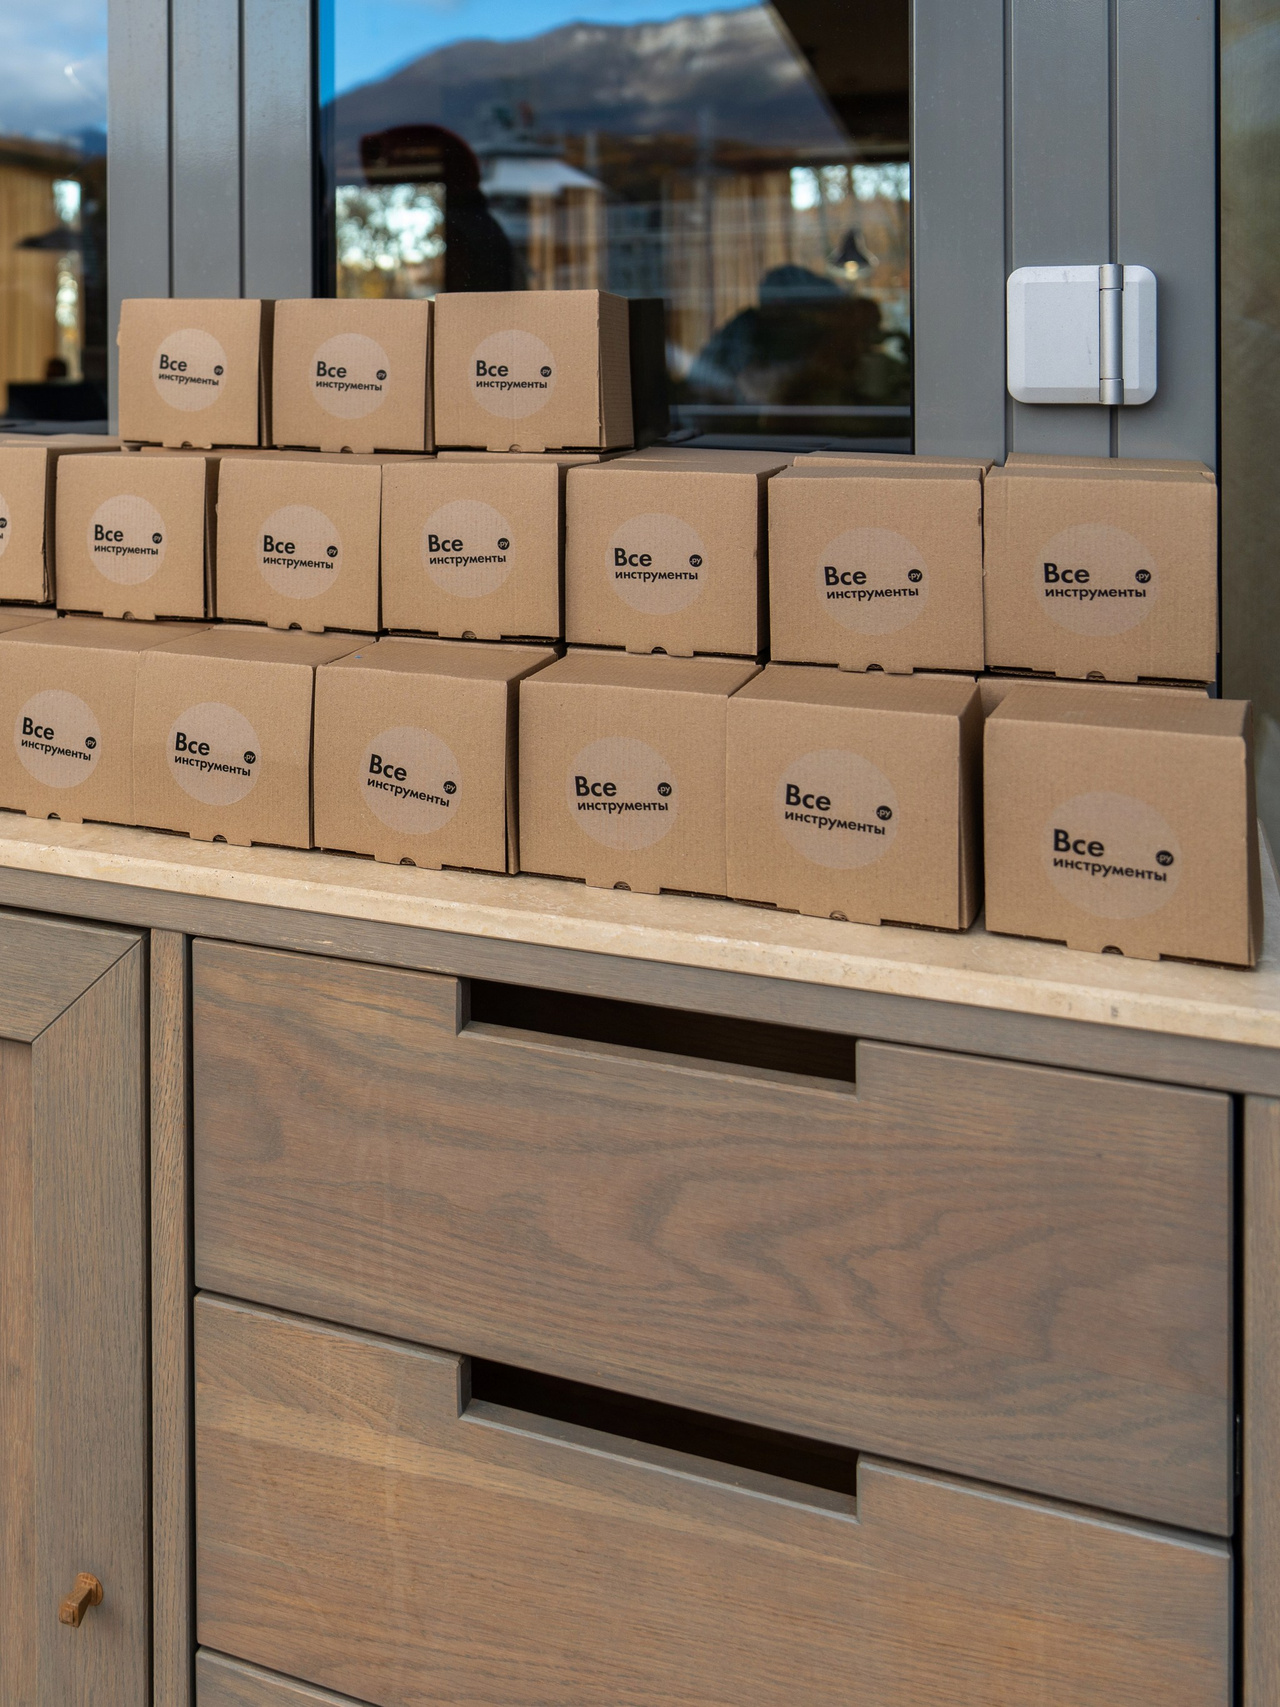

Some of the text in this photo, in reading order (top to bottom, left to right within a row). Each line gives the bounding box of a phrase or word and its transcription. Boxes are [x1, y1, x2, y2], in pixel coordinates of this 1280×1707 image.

[159, 353, 188, 372] Все
[316, 360, 347, 379] Все
[476, 359, 509, 378] Все
[158, 373, 220, 387] инструменты
[315, 380, 383, 392] инструменты
[475, 380, 548, 391] инструменты
[94, 523, 124, 543] Все
[94, 545, 159, 557] инструменты
[263, 534, 296, 555] Все
[427, 534, 464, 553] Все
[262, 556, 334, 570] инструменты
[429, 555, 507, 567] инструменты
[614, 547, 653, 568] Все
[615, 571, 699, 583] инструменты
[823, 565, 867, 587] Все
[1043, 562, 1090, 584] Все
[826, 587, 920, 602] инструменты
[1044, 588, 1147, 601] инструменты
[22, 716, 55, 741] Все
[21, 739, 92, 762] инструменты
[175, 731, 211, 756] Все
[174, 755, 251, 777] инструменты
[368, 753, 408, 782] Все
[367, 778, 450, 808] инструменты
[574, 775, 617, 798] Все
[785, 783, 832, 812] Все
[577, 801, 669, 815] инструменты
[784, 810, 886, 836] инструменты
[1053, 828, 1105, 858] Все
[1053, 857, 1167, 882] инструменты
